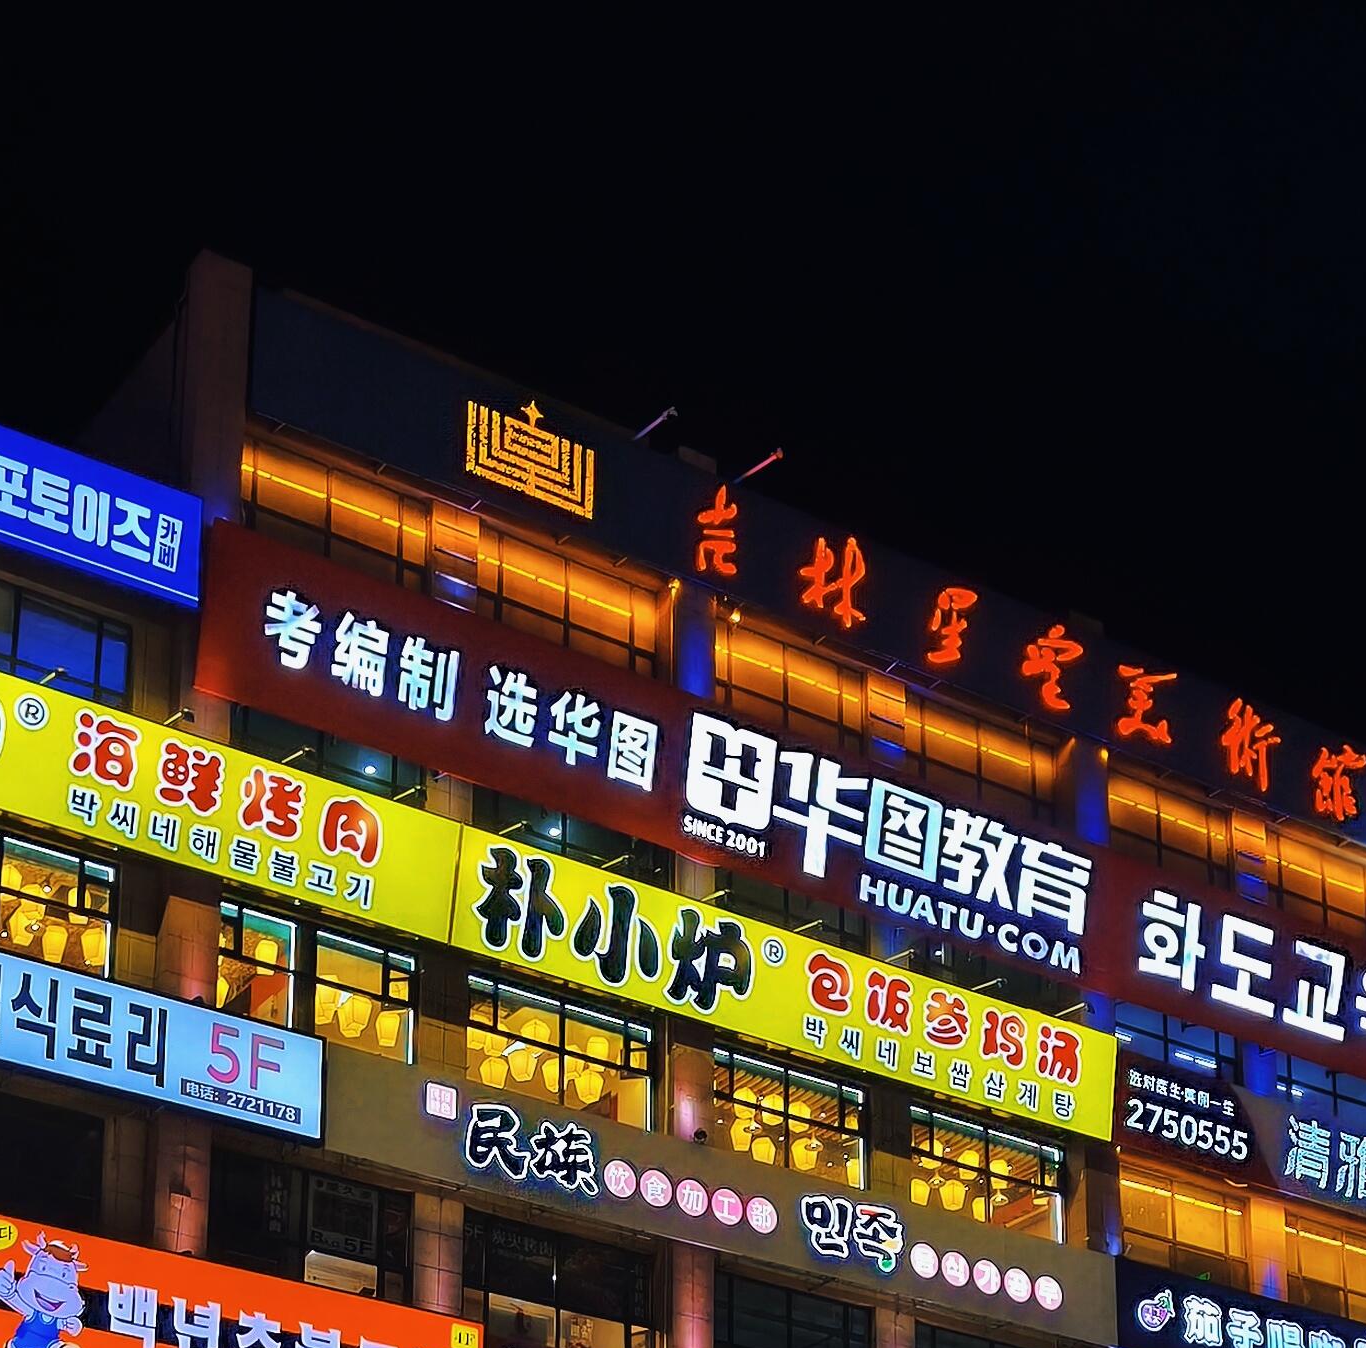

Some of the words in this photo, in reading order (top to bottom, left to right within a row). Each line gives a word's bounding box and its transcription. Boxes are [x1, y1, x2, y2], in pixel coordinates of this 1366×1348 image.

[264, 591, 460, 722] 考编制
[485, 666, 659, 792] 选华图
[70, 713, 383, 865] 海鲜烤肉
[683, 816, 723, 846] SINCE
[726, 830, 767, 858] 2001
[478, 848, 752, 1010] 朴小炉
[206, 1022, 285, 1090] 5F
[806, 953, 1082, 1086] 包饭参鸡汤
[225, 1090, 297, 1122] 2721178
[1127, 1098, 1247, 1161] 2750555
[467, 1104, 599, 1197] 民族
[605, 1160, 779, 1234] 饮食加工部
[802, 1196, 904, 1273] 민족
